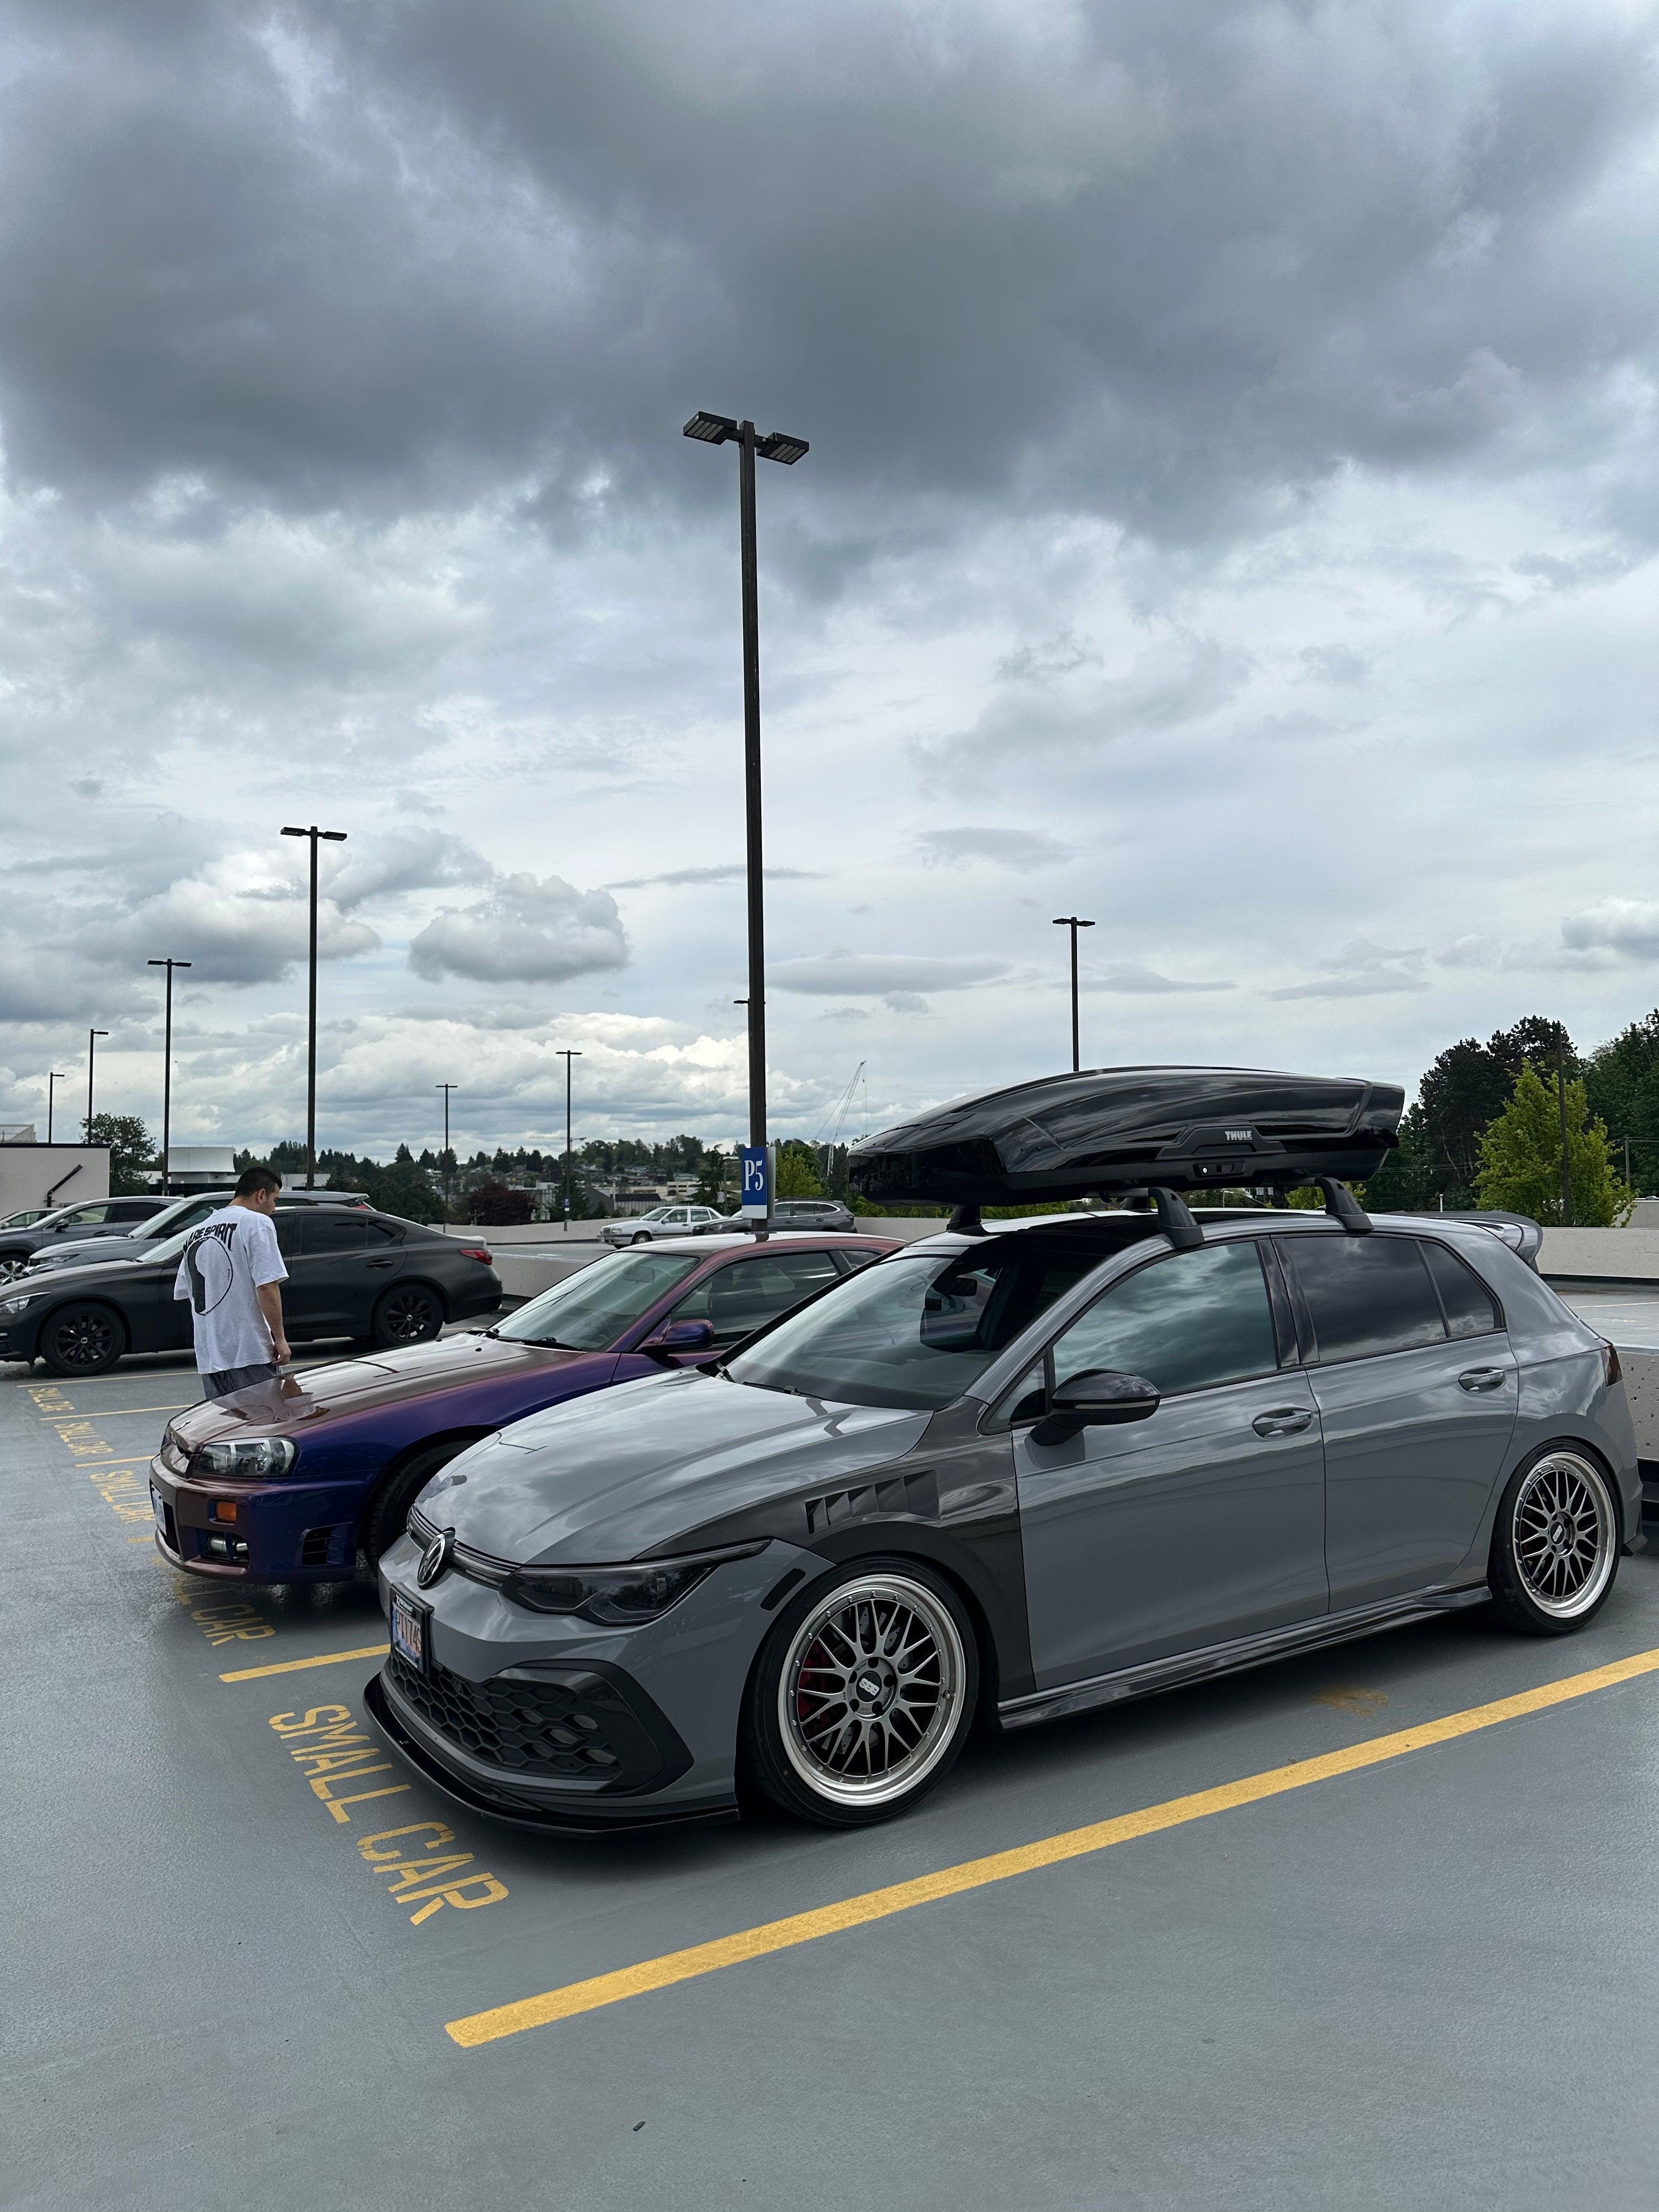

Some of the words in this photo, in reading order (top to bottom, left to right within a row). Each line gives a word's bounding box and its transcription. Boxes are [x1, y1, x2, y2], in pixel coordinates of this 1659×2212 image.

[1224, 1131, 1252, 1141] THULE
[744, 1159, 764, 1191] P5
[28, 1388, 65, 1403] SMALL
[38, 1401, 75, 1413] CAR
[54, 1422, 100, 1442] SMALL
[67, 1441, 114, 1457] CAR
[89, 1470, 150, 1502] SMALL
[191, 1603, 276, 1646] CAR
[859, 1678, 880, 1696] BBS
[268, 1704, 412, 1824] SMALL
[356, 1821, 509, 1926] CAR
